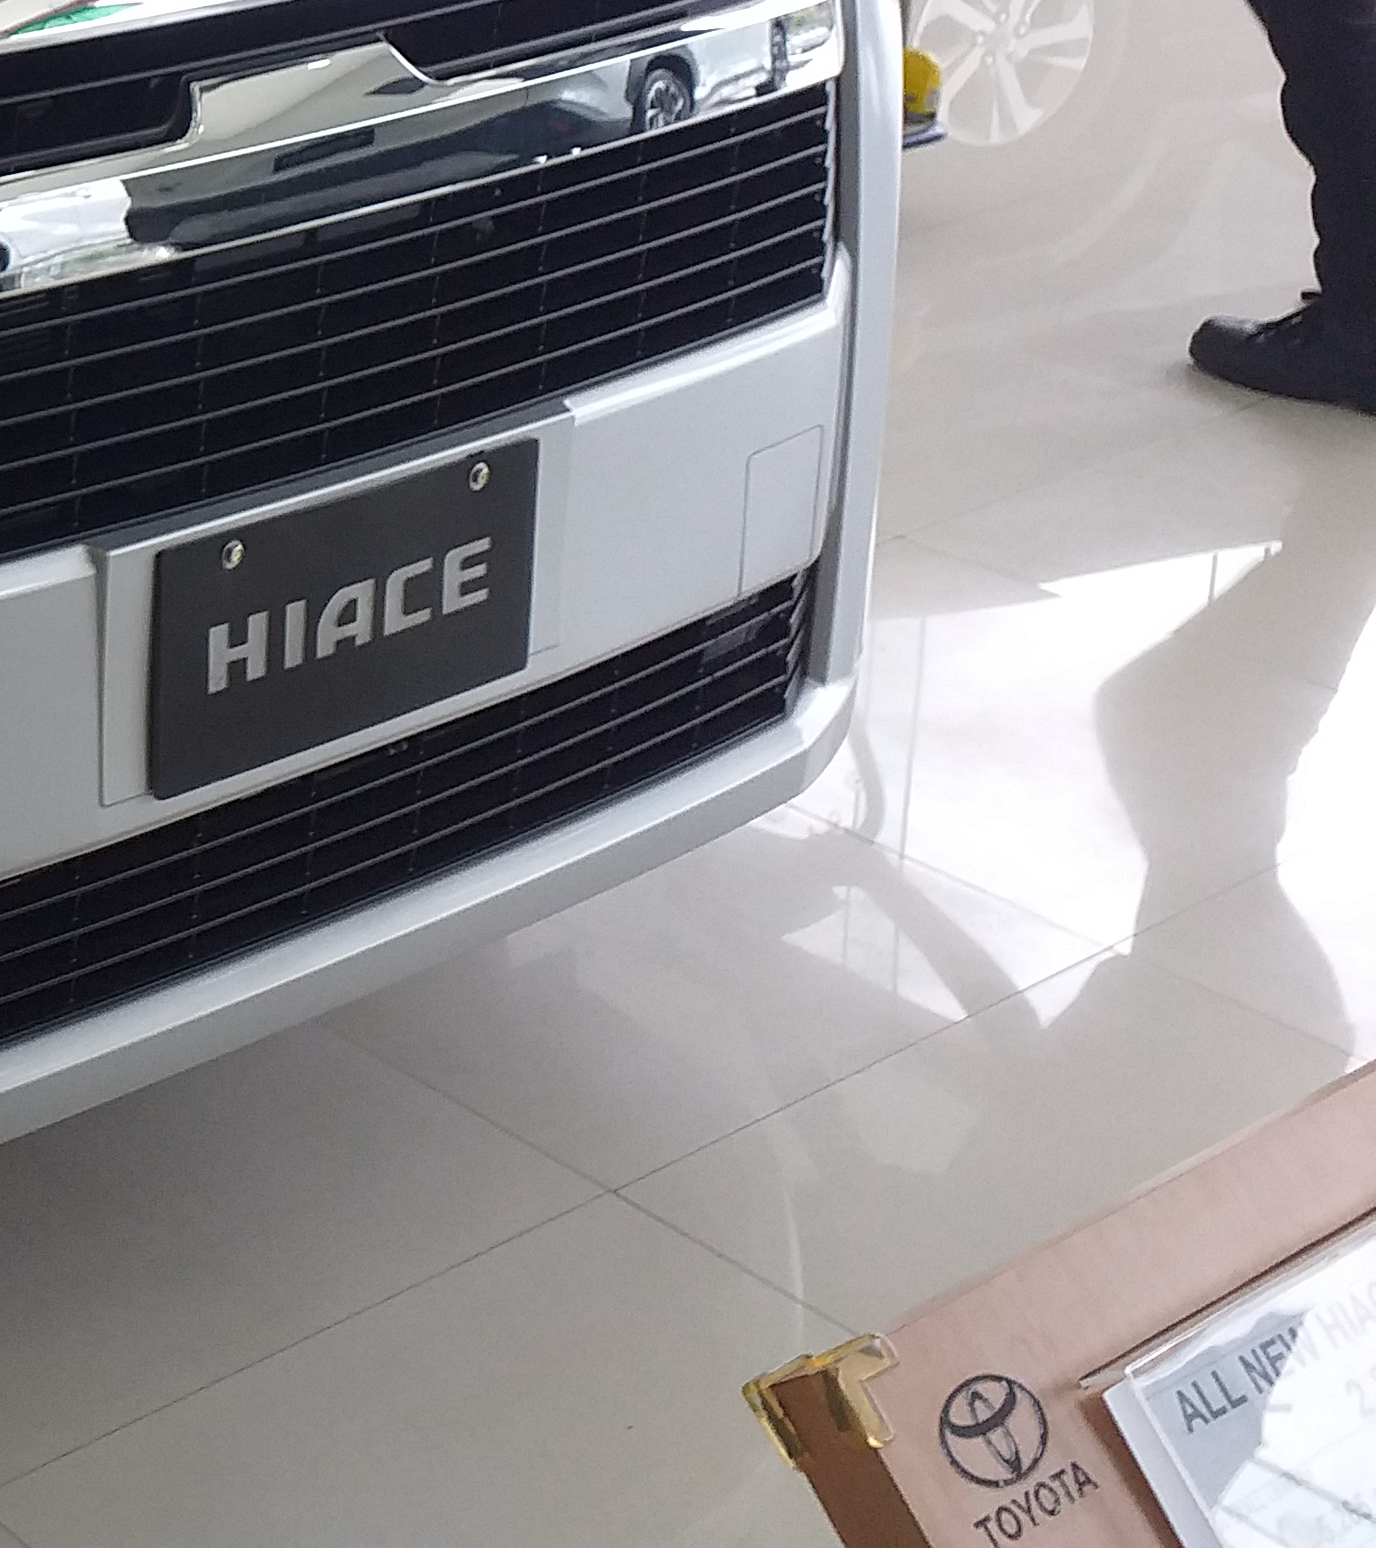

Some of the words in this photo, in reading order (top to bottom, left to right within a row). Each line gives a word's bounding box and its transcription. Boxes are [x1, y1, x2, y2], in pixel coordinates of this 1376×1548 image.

[206, 536, 493, 695] HIACE
[1175, 1369, 1249, 1434] ALL
[972, 1460, 1101, 1548] TOYOTA
